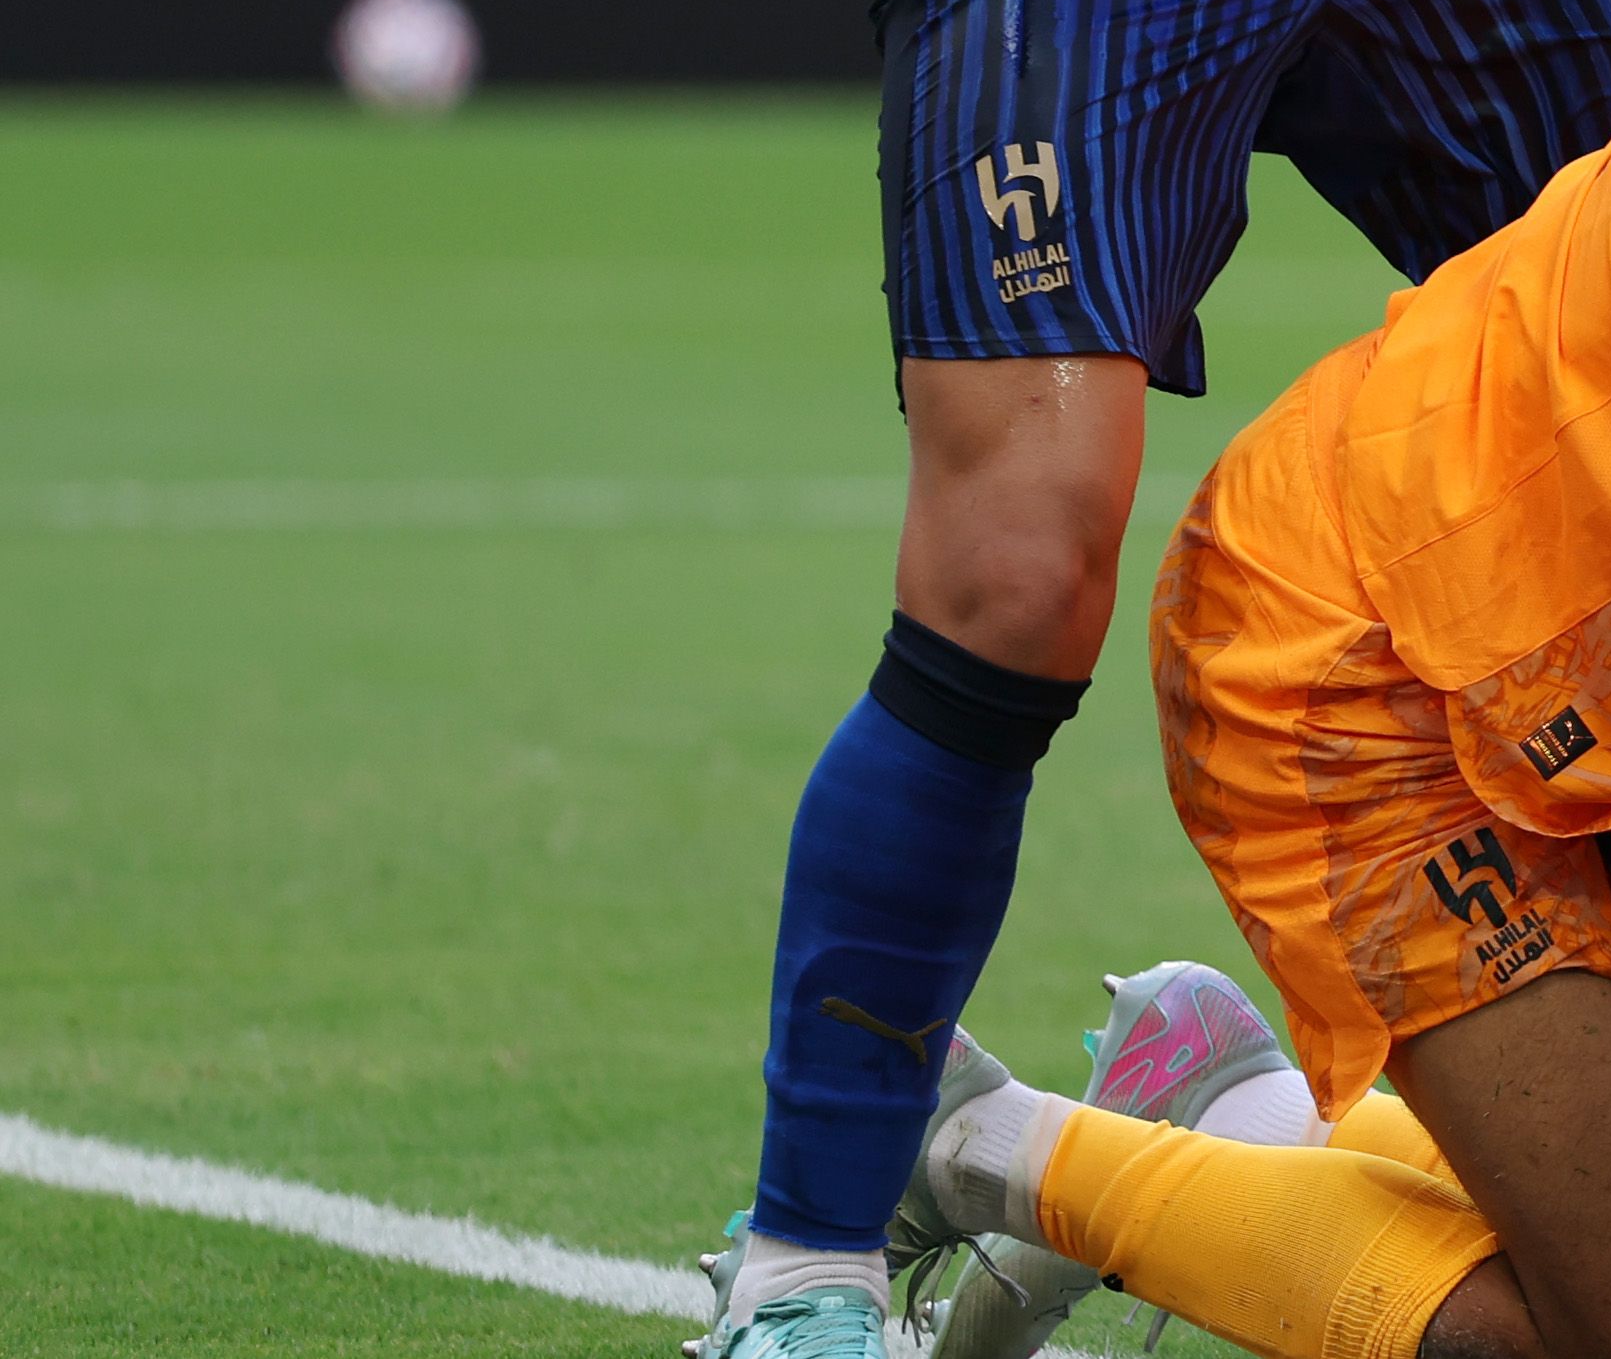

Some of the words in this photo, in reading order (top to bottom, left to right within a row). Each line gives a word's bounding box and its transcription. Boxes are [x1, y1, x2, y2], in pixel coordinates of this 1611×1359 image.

[993, 242, 1071, 280] ALHILAL
[1000, 265, 1071, 304] الهلال
[1475, 908, 1548, 966] ALHILAL
